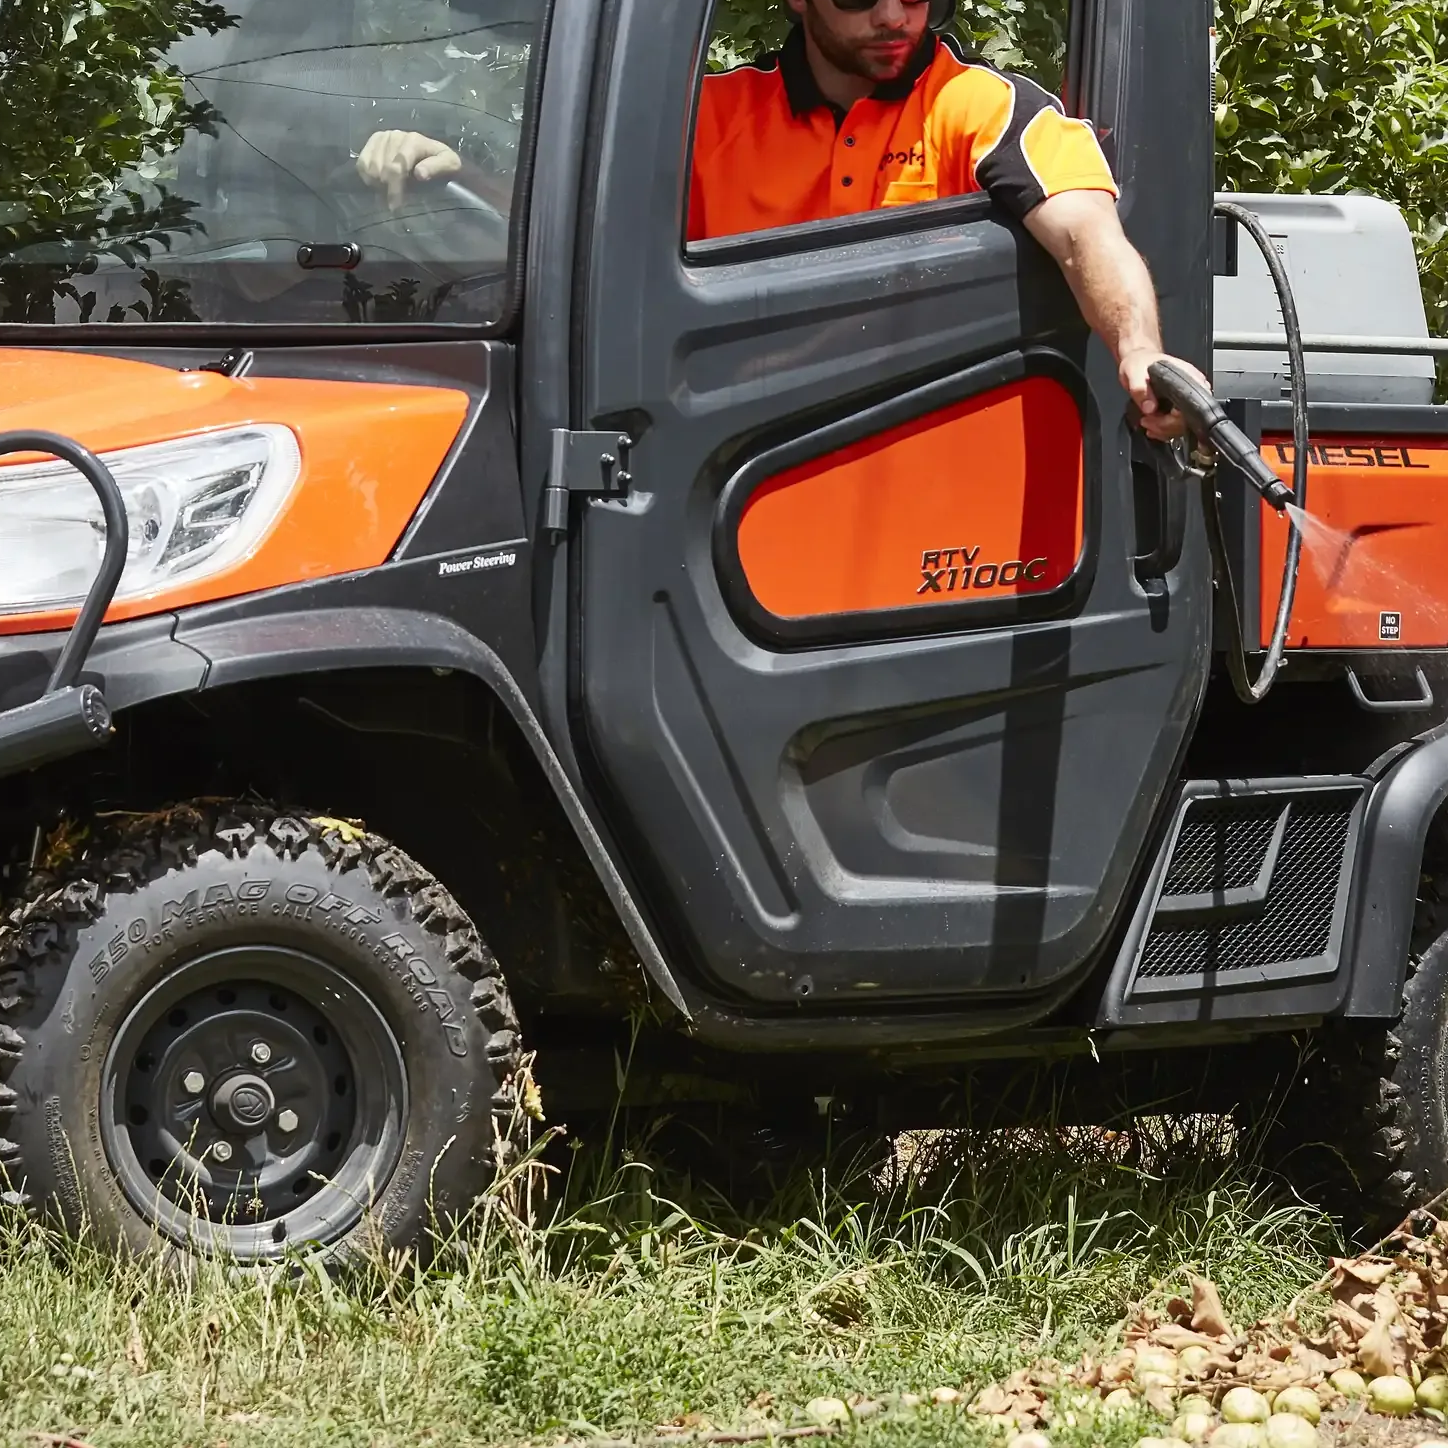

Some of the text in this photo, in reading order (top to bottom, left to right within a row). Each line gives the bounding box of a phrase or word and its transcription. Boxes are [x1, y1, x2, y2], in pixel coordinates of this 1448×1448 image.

[438, 552, 517, 575] Power Steering
[920, 545, 981, 570] RTV
[916, 556, 1048, 595] X1100C
[1381, 625, 1399, 635] STEP
[1385, 616, 1396, 625] NO
[141, 927, 175, 954] FOR
[183, 902, 260, 930] SERVICE
[271, 902, 313, 921] CALL
[88, 879, 469, 1057] 350 MAG OFF ROAD
